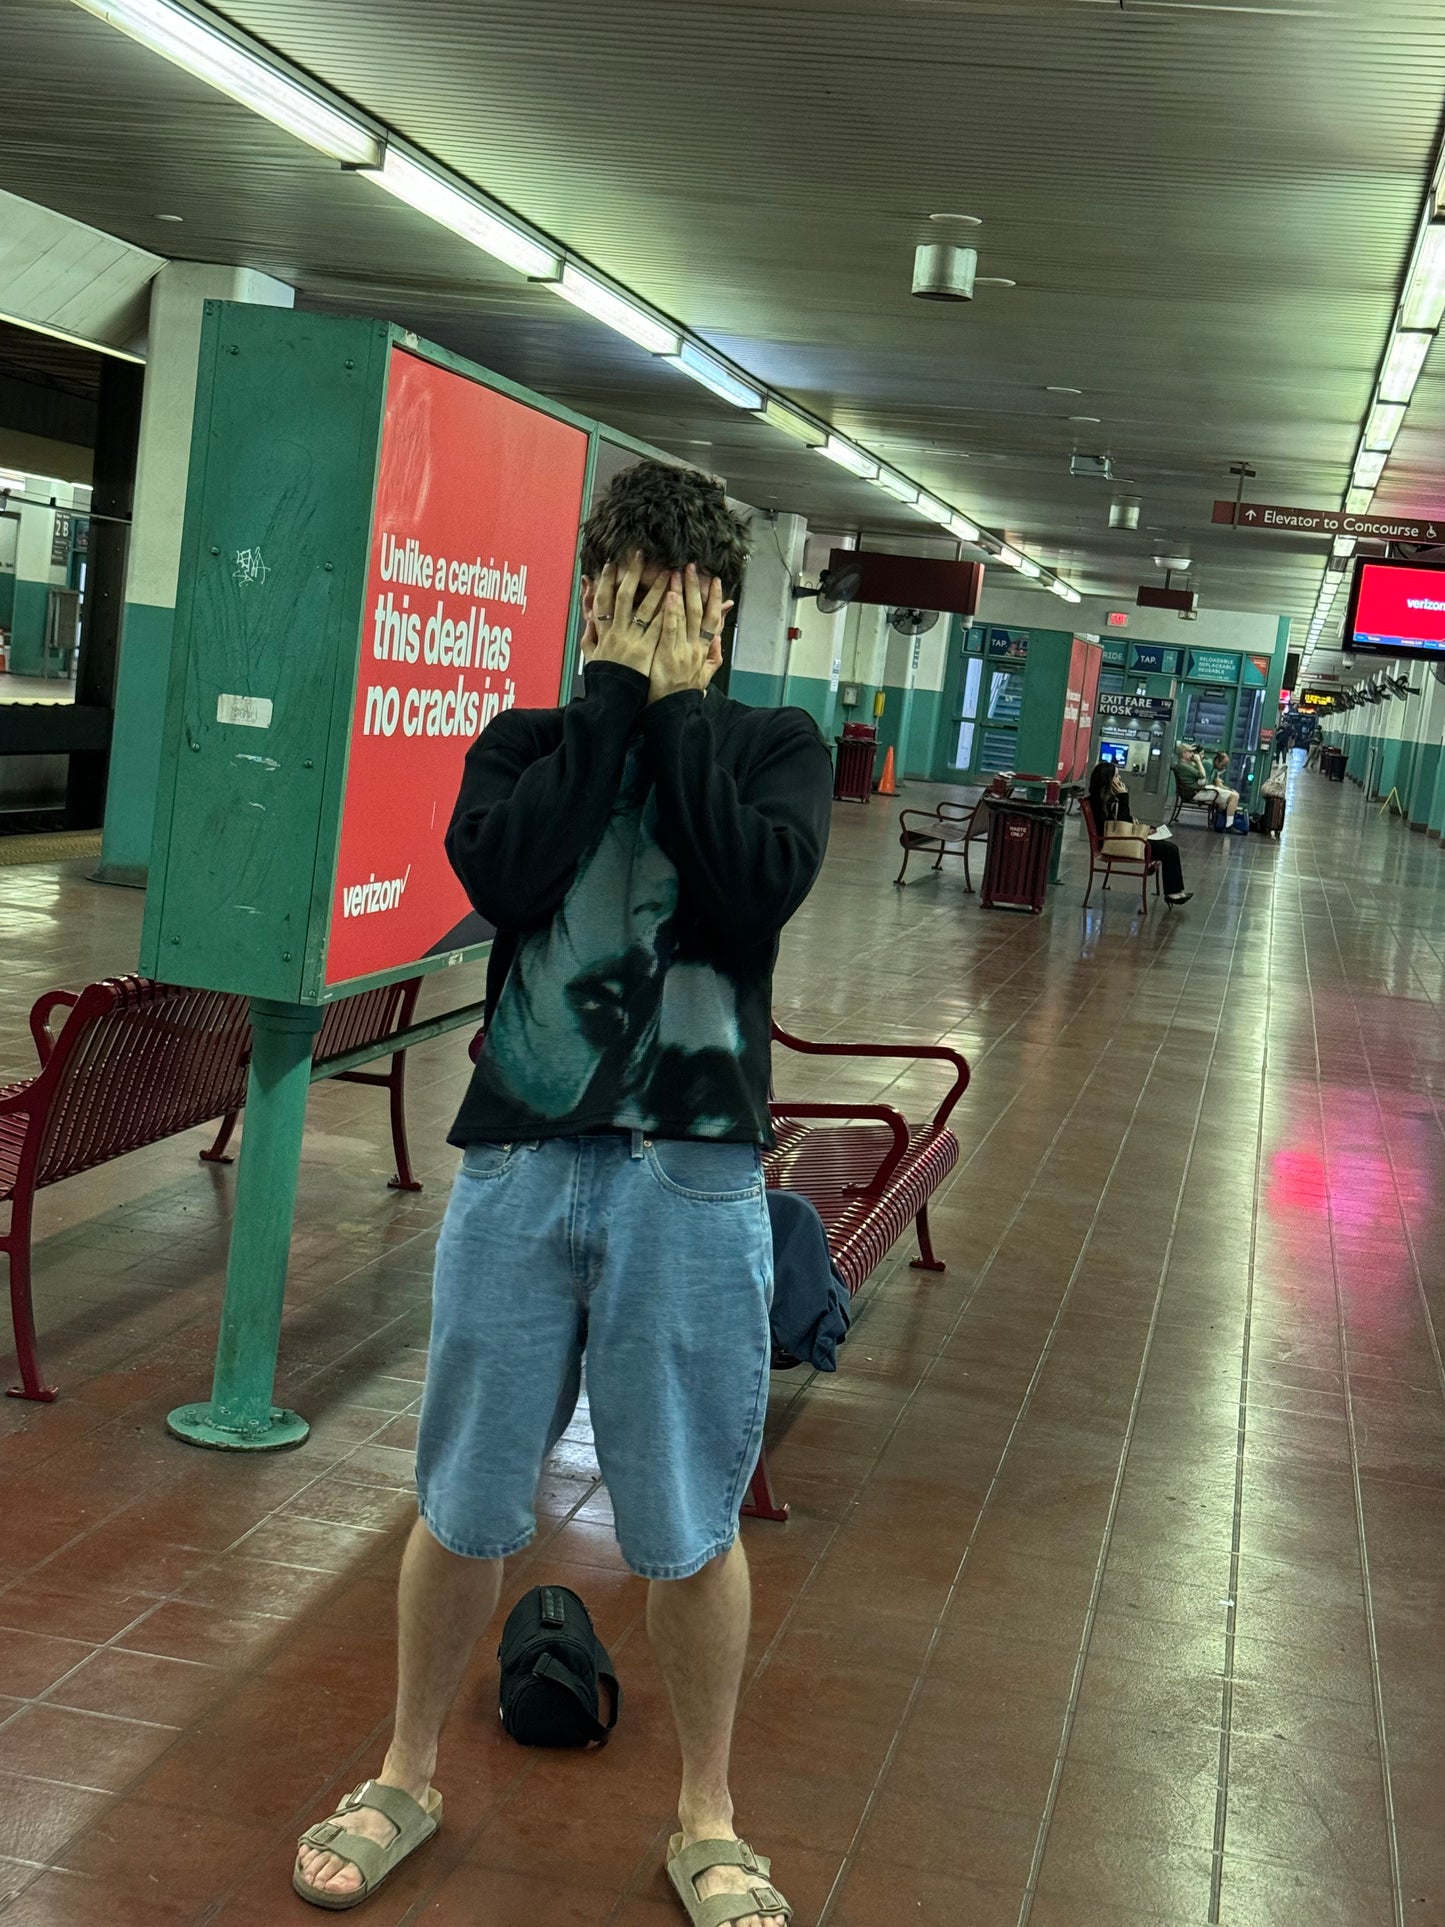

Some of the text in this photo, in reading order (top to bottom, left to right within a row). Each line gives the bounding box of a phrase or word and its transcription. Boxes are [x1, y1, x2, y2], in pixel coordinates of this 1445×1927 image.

[1263, 509, 1419, 538] Elevator to Concourse
[380, 532, 528, 615] Unlike a certain bell,
[1406, 597, 1445, 612] verizon
[373, 591, 512, 672] this deal has
[1102, 651, 1123, 661] RIDE
[1140, 655, 1157, 665] TAP.
[363, 684, 401, 737] no
[402, 674, 480, 738] cracks
[1099, 703, 1133, 716] KIOSK
[1100, 694, 1123, 705] EXIT
[1124, 696, 1153, 708] FARE
[342, 872, 401, 919] verizon
